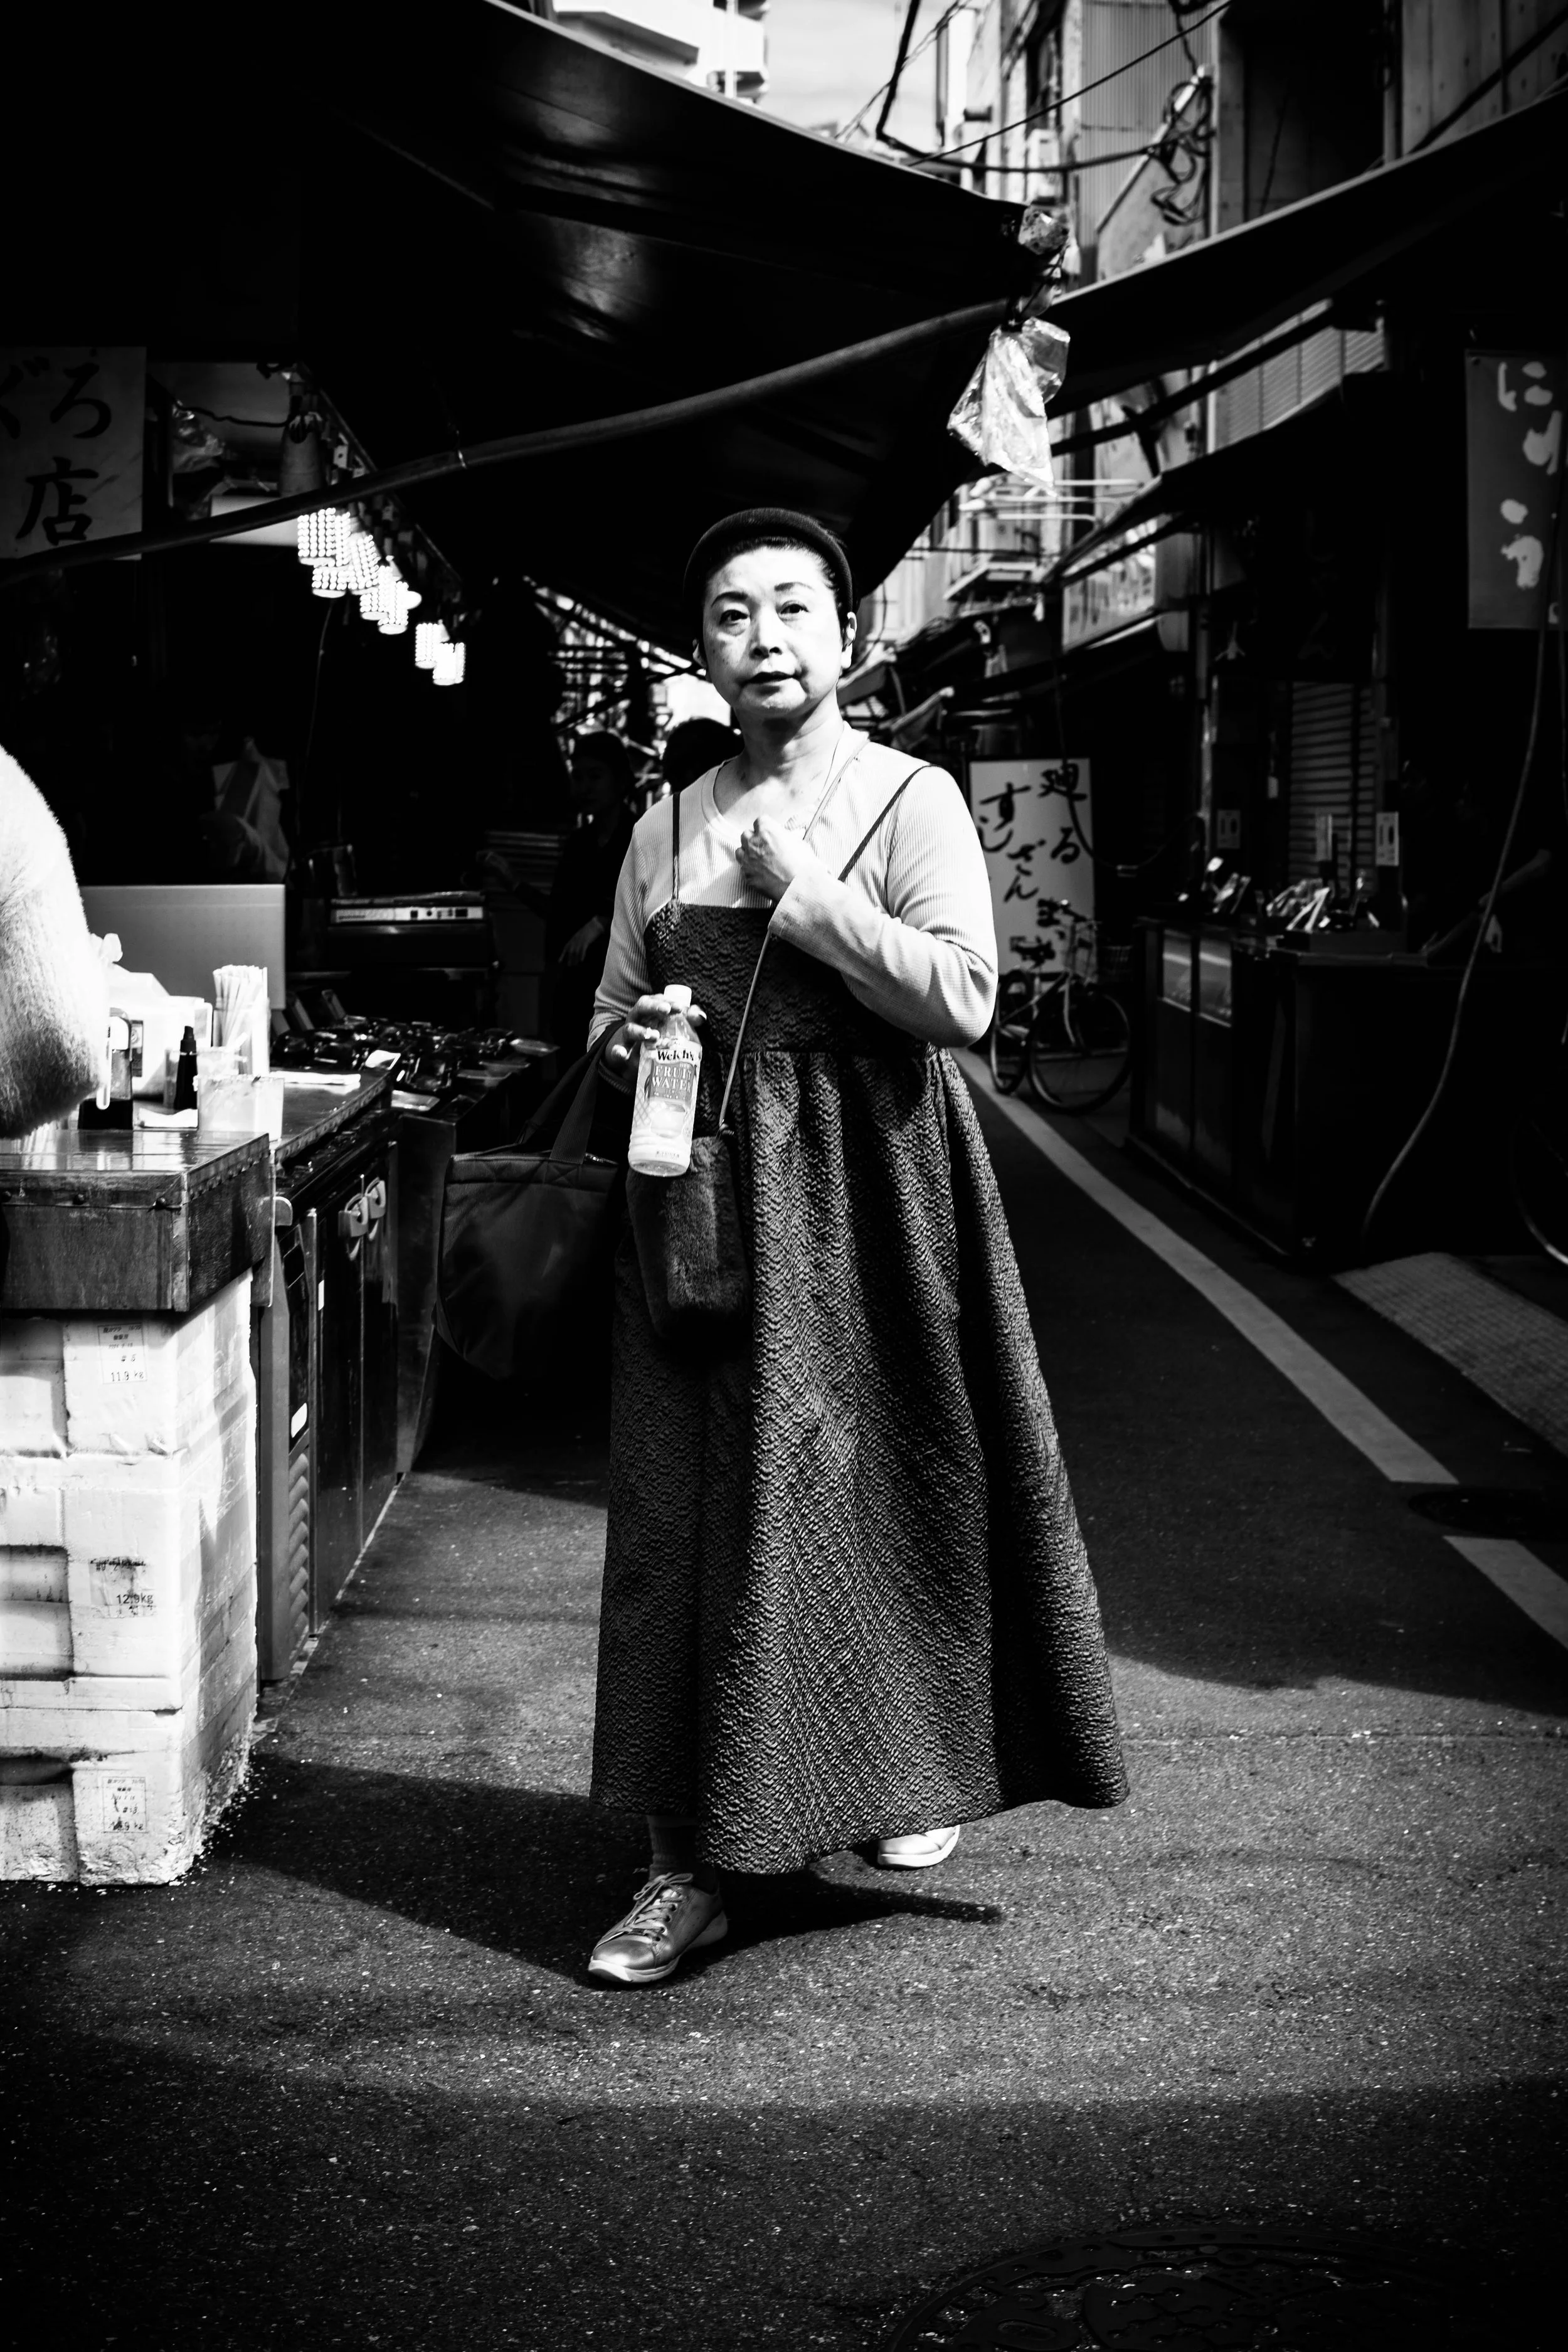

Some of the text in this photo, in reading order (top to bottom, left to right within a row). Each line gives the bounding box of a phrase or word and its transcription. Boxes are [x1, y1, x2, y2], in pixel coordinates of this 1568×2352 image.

[15, 456, 99, 546] 店
[655, 1065, 691, 1081] FRUIT
[652, 1076, 691, 1093] WATER
